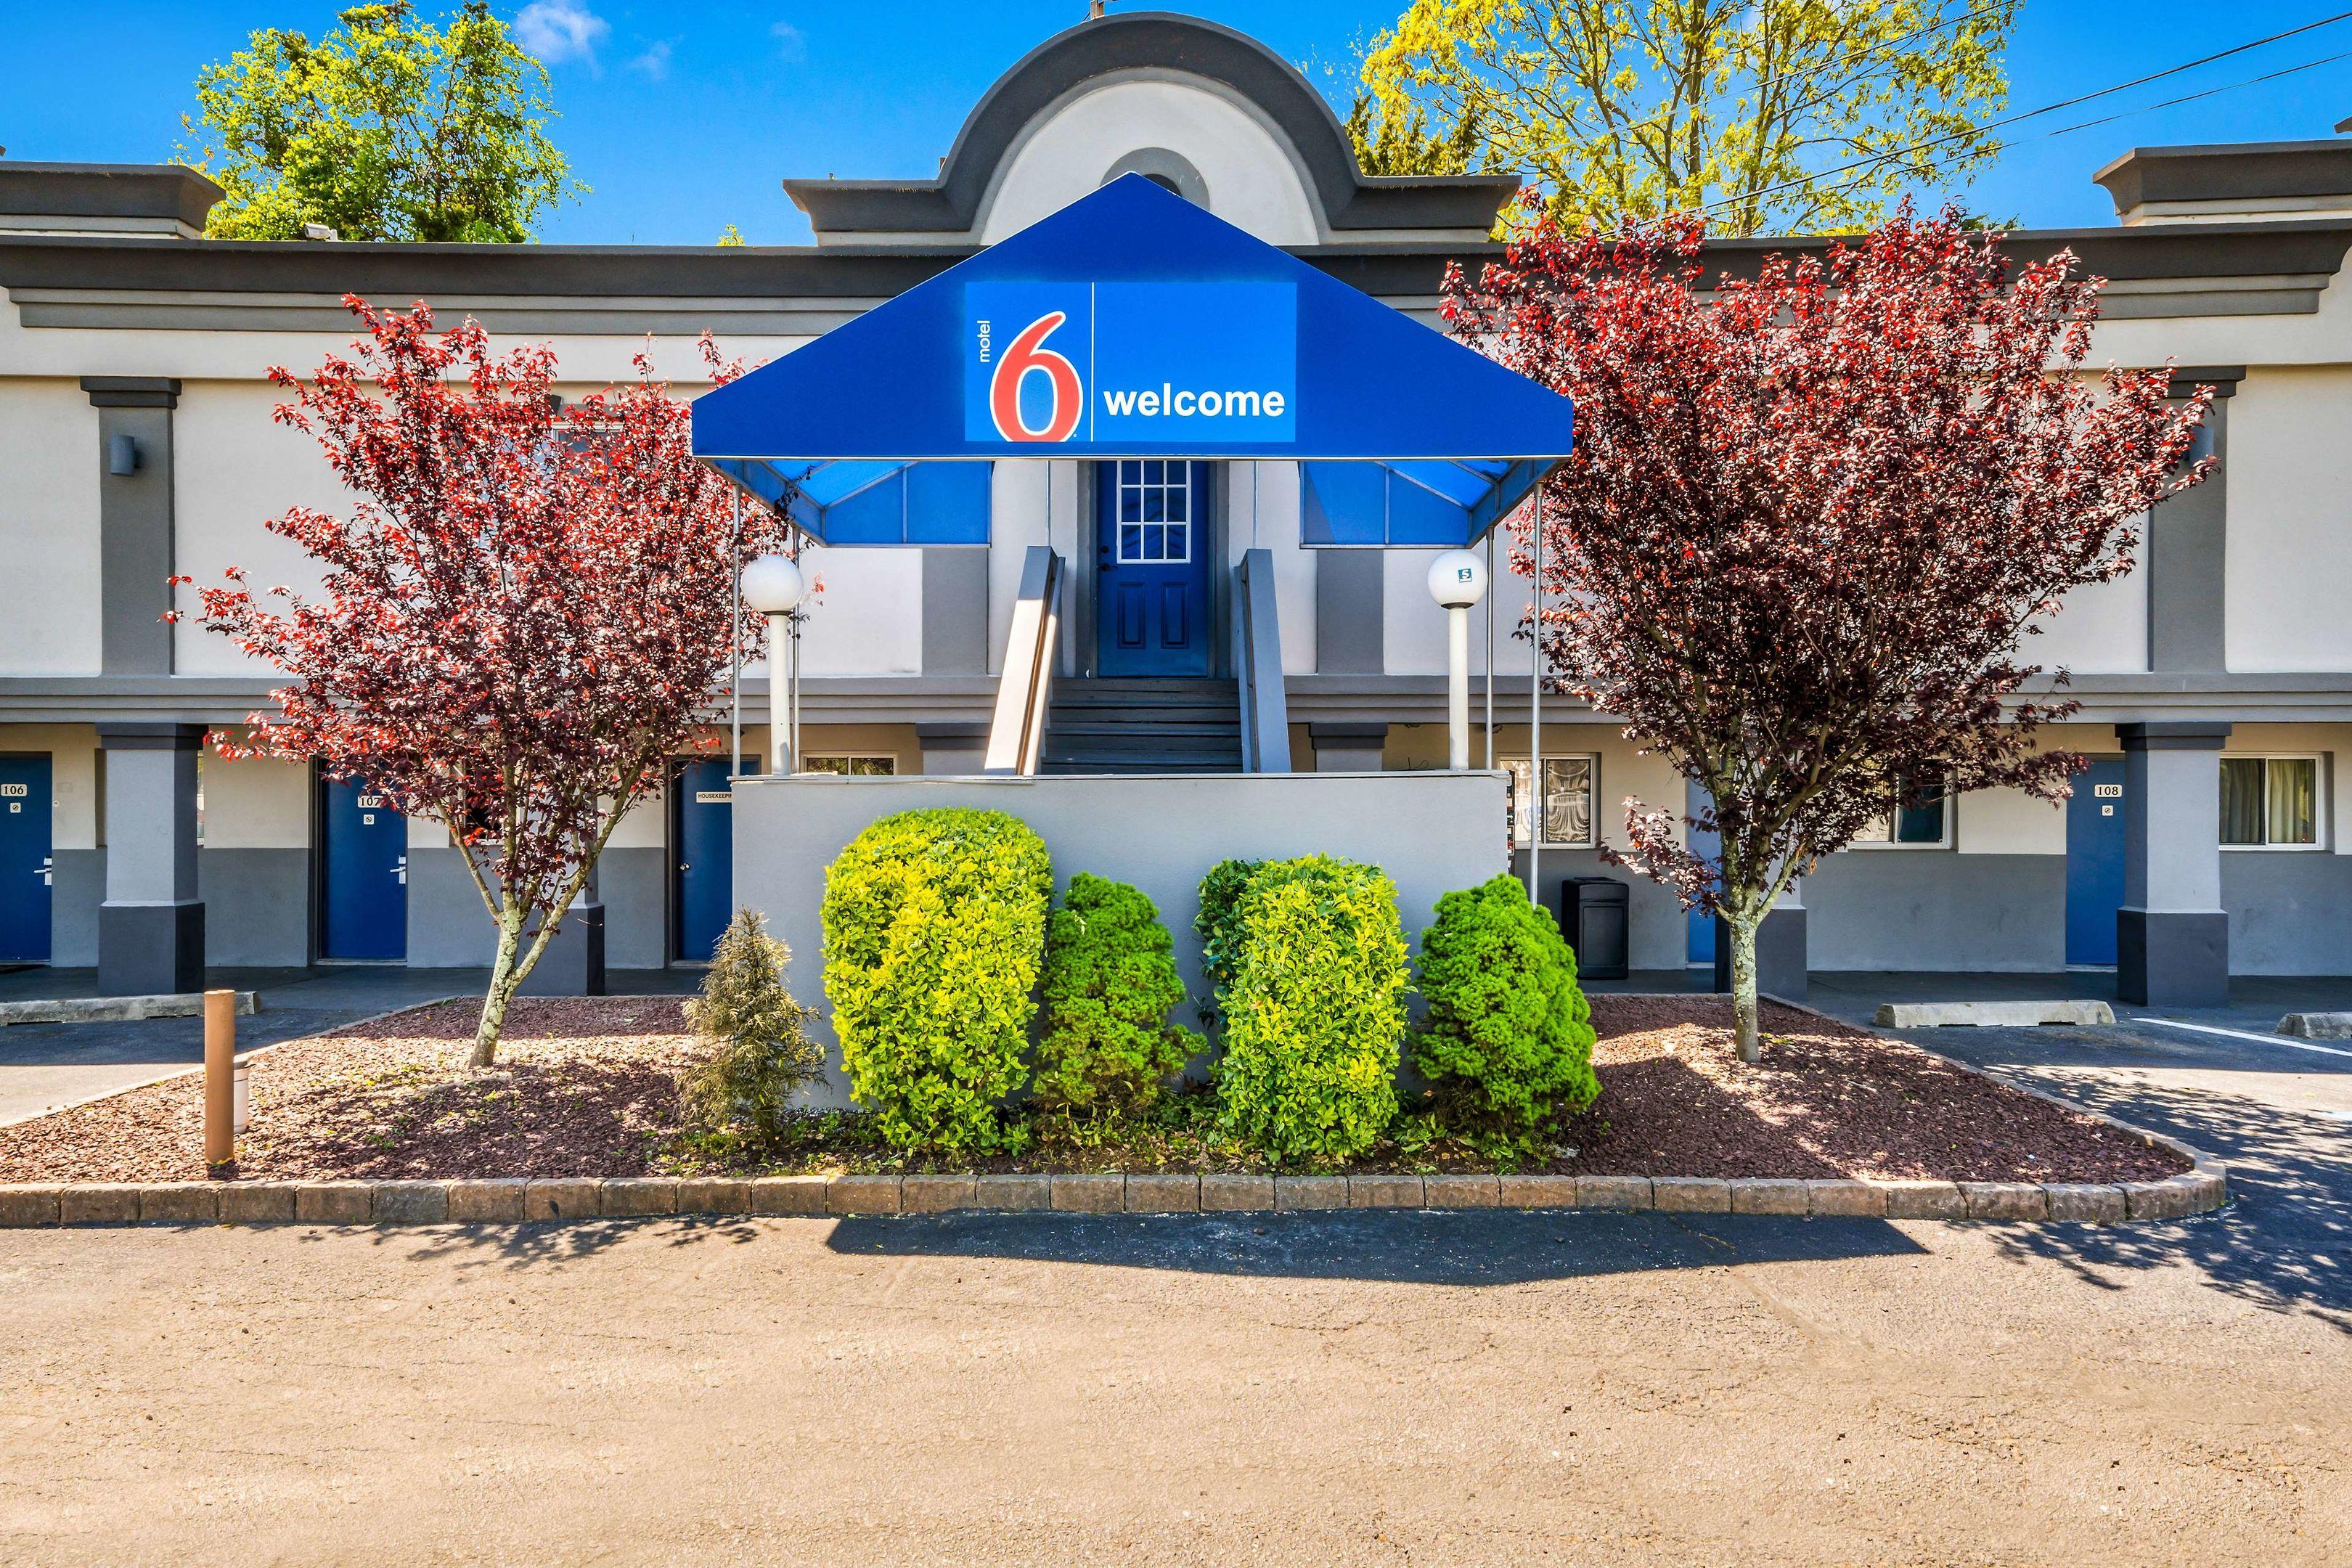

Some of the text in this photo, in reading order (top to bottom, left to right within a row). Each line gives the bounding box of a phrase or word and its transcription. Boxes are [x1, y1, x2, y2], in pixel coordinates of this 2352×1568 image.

[976, 310, 1084, 442] motel 6
[1103, 383, 1285, 417] welcome
[4, 785, 24, 795] 106
[2098, 786, 2119, 796] 108
[361, 797, 381, 807] 107
